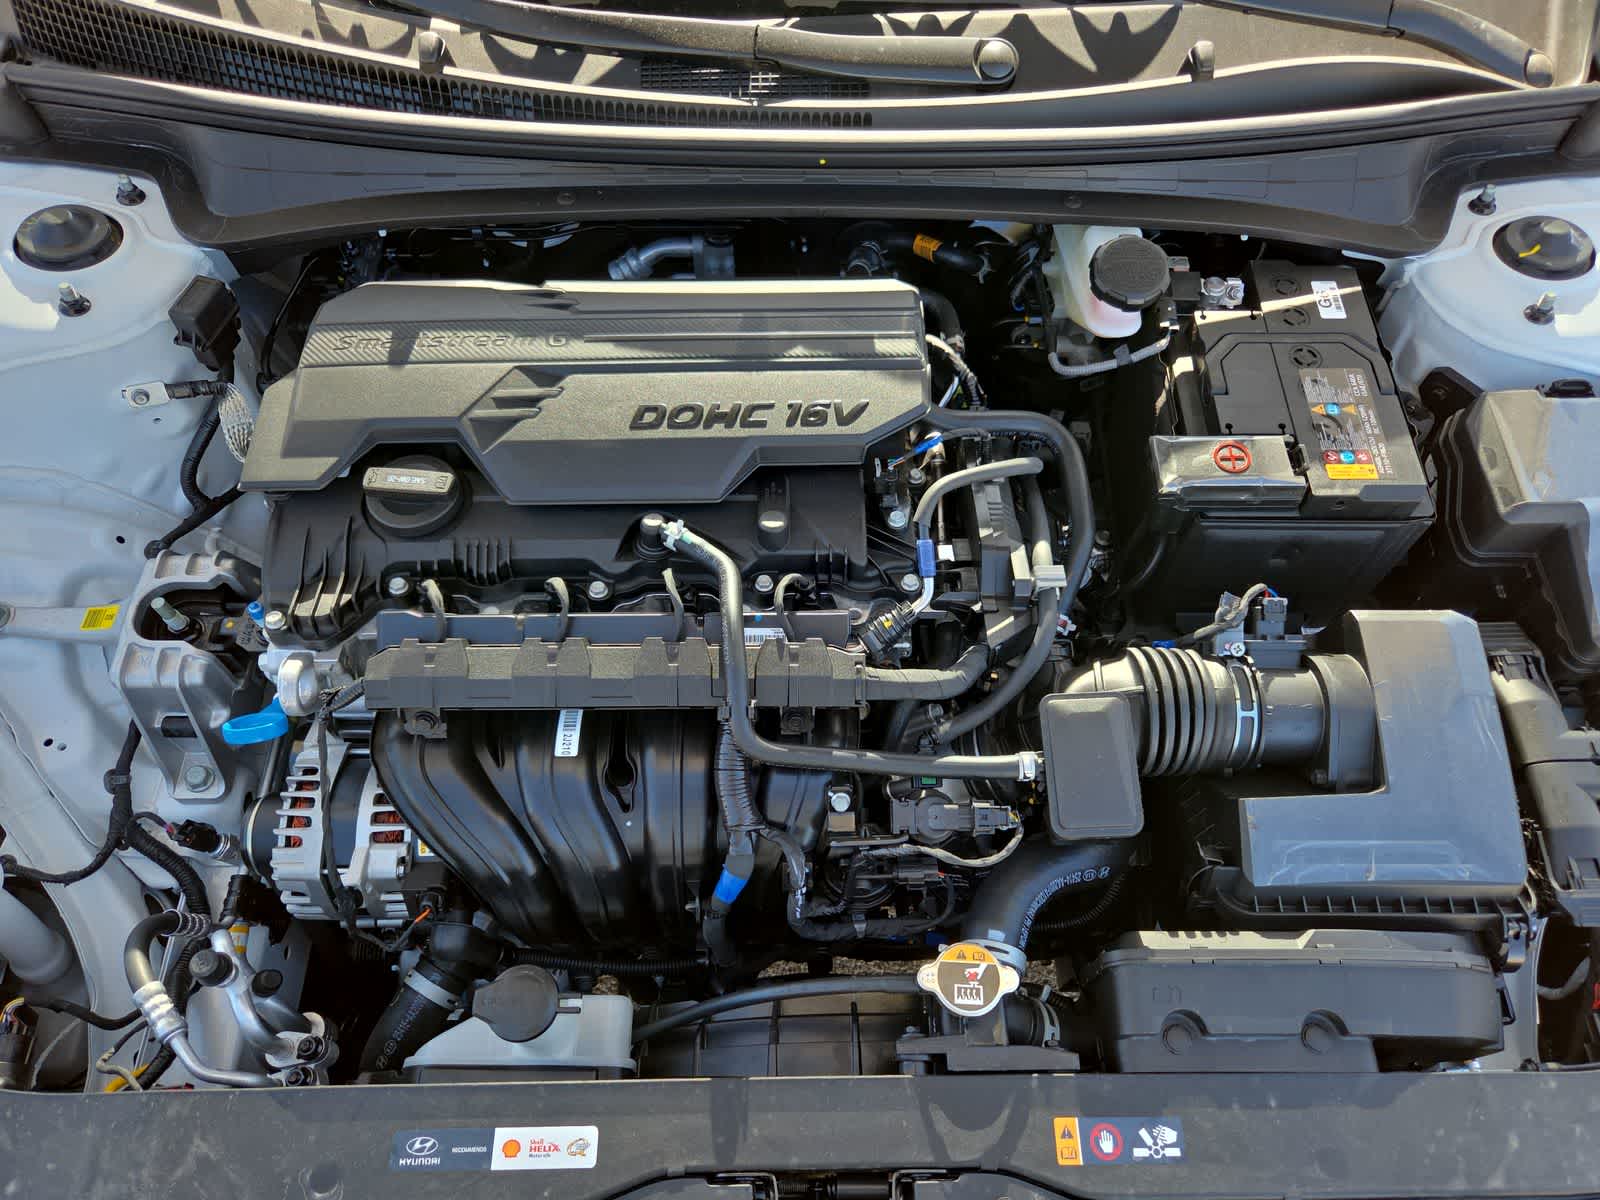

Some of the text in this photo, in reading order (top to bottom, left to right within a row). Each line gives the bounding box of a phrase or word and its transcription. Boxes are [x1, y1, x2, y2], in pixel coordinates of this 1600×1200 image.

[334, 333, 539, 351] Smatstream
[629, 399, 869, 431] DOHC 16V
[529, 1143, 560, 1153] HELIX
[399, 1157, 440, 1167] HYUNDAI
